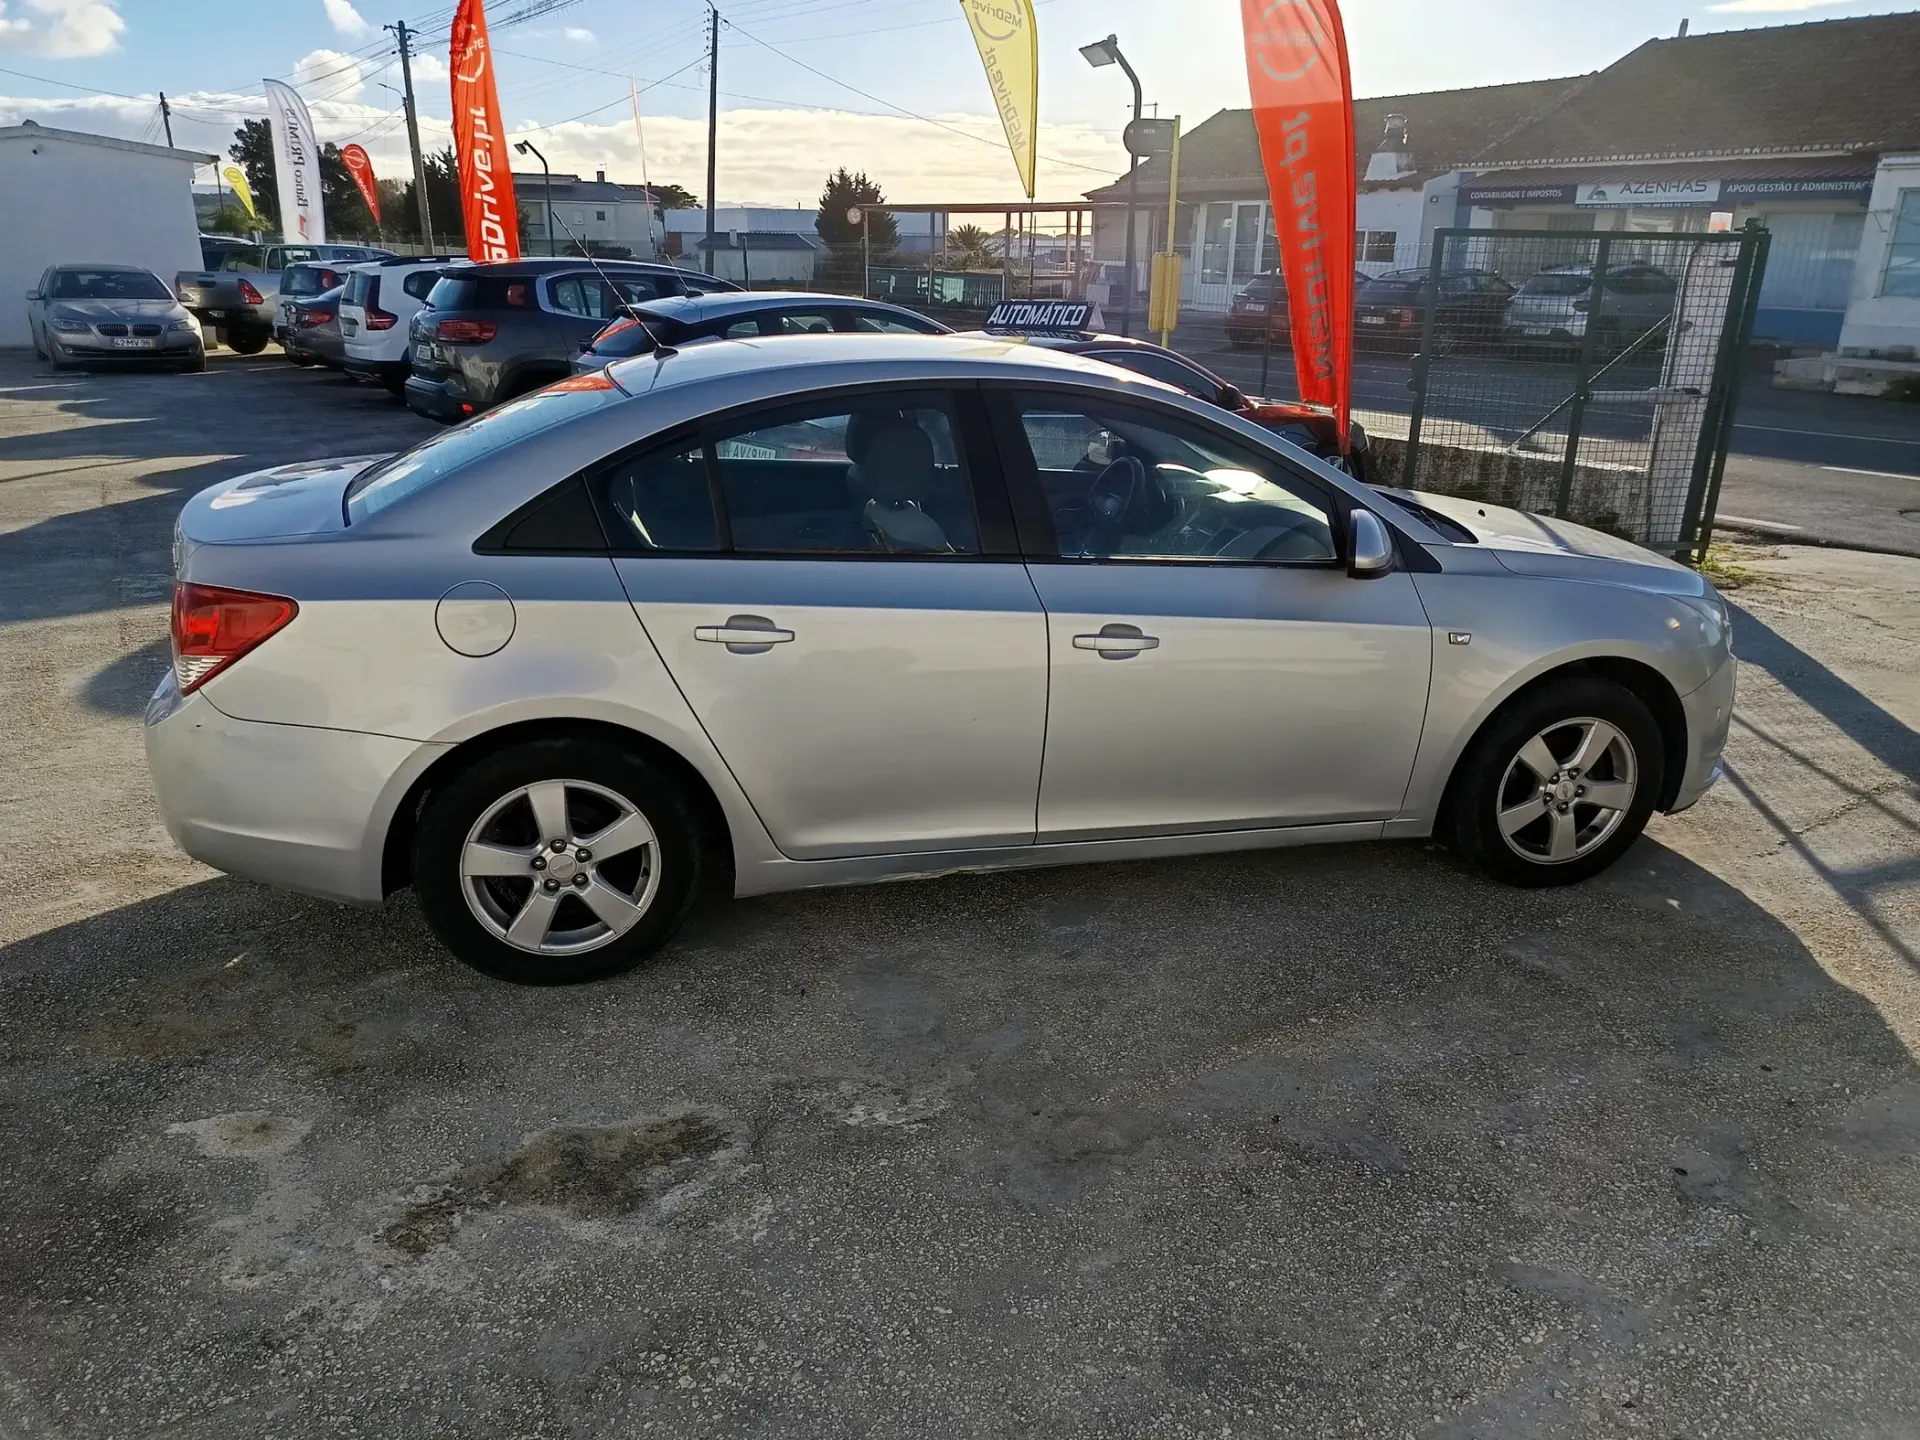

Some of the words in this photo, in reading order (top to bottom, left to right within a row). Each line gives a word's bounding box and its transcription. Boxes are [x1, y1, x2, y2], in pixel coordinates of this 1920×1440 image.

[1620, 179, 1707, 194] AZENHAS
[1726, 183, 1754, 193] APOIO
[1757, 181, 1792, 192] GESTÃO
[1793, 182, 1800, 191] E
[1470, 190, 1520, 199] CONTABILIDADE
[1521, 190, 1526, 198] E
[1526, 189, 1562, 198] IMPOSTOS
[987, 302, 1087, 326] AUTOMÁTICO
